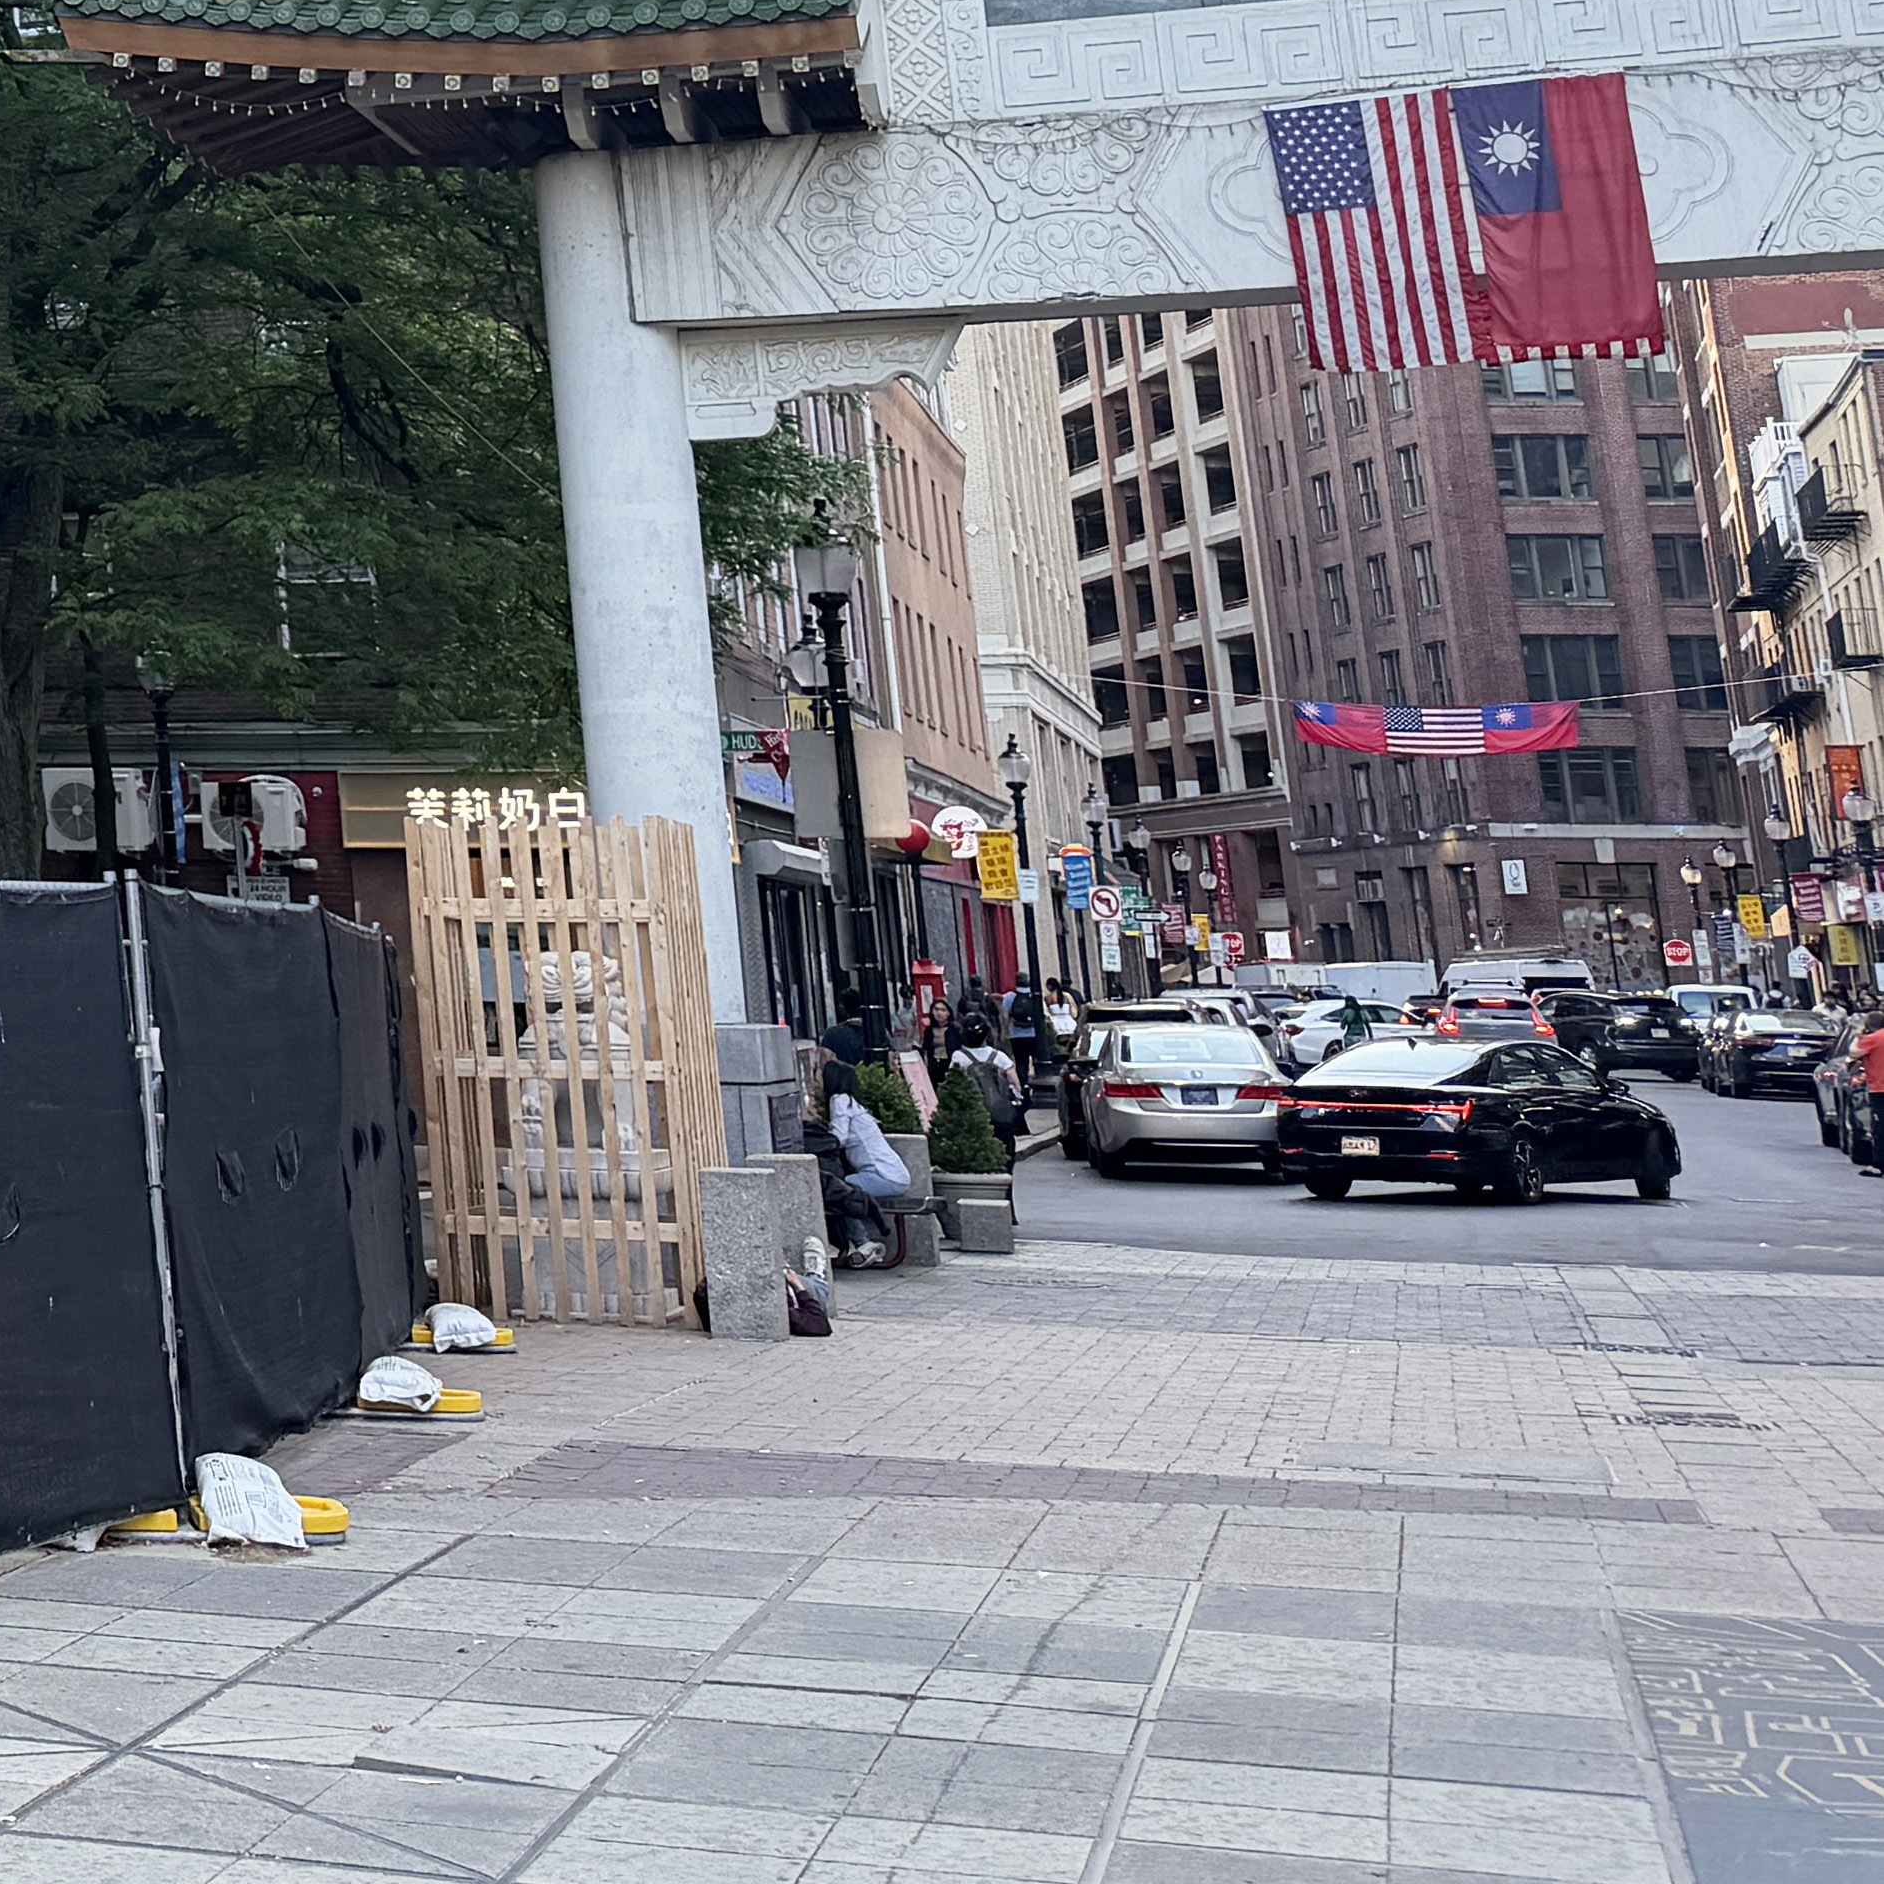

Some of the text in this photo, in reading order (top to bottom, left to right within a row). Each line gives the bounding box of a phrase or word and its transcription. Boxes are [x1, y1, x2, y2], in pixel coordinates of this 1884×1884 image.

[405, 786, 586, 832] 茉莉奶白
[1214, 834, 1229, 896] PARKING
[260, 882, 288, 893] HOUR
[1665, 946, 1690, 957] STOP
